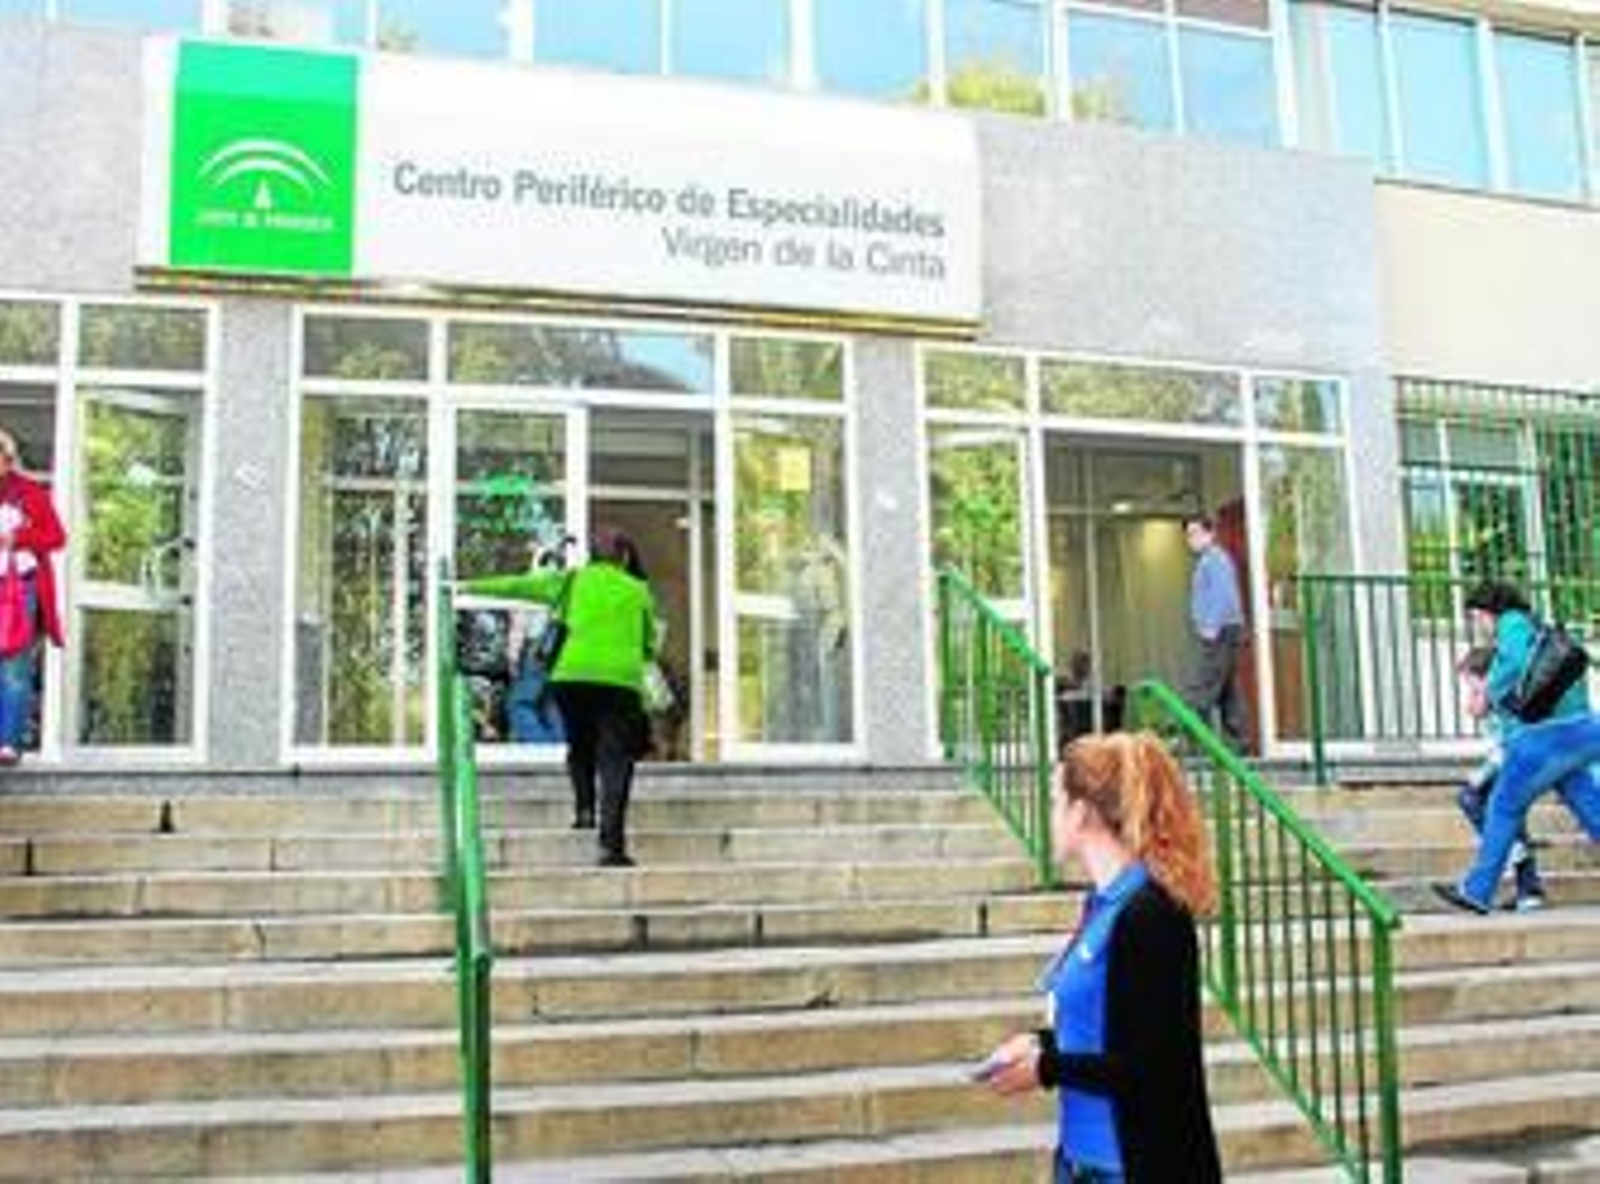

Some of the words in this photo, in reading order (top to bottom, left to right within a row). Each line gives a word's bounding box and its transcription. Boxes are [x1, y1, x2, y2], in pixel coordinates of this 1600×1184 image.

[393, 161, 501, 199] Centro
[513, 169, 665, 212] Periférico
[676, 185, 715, 216] de
[728, 188, 945, 237] Especialidades
[662, 226, 762, 267] Virgen
[774, 238, 815, 266] de
[828, 240, 853, 270] la
[866, 242, 945, 280] Cinta
